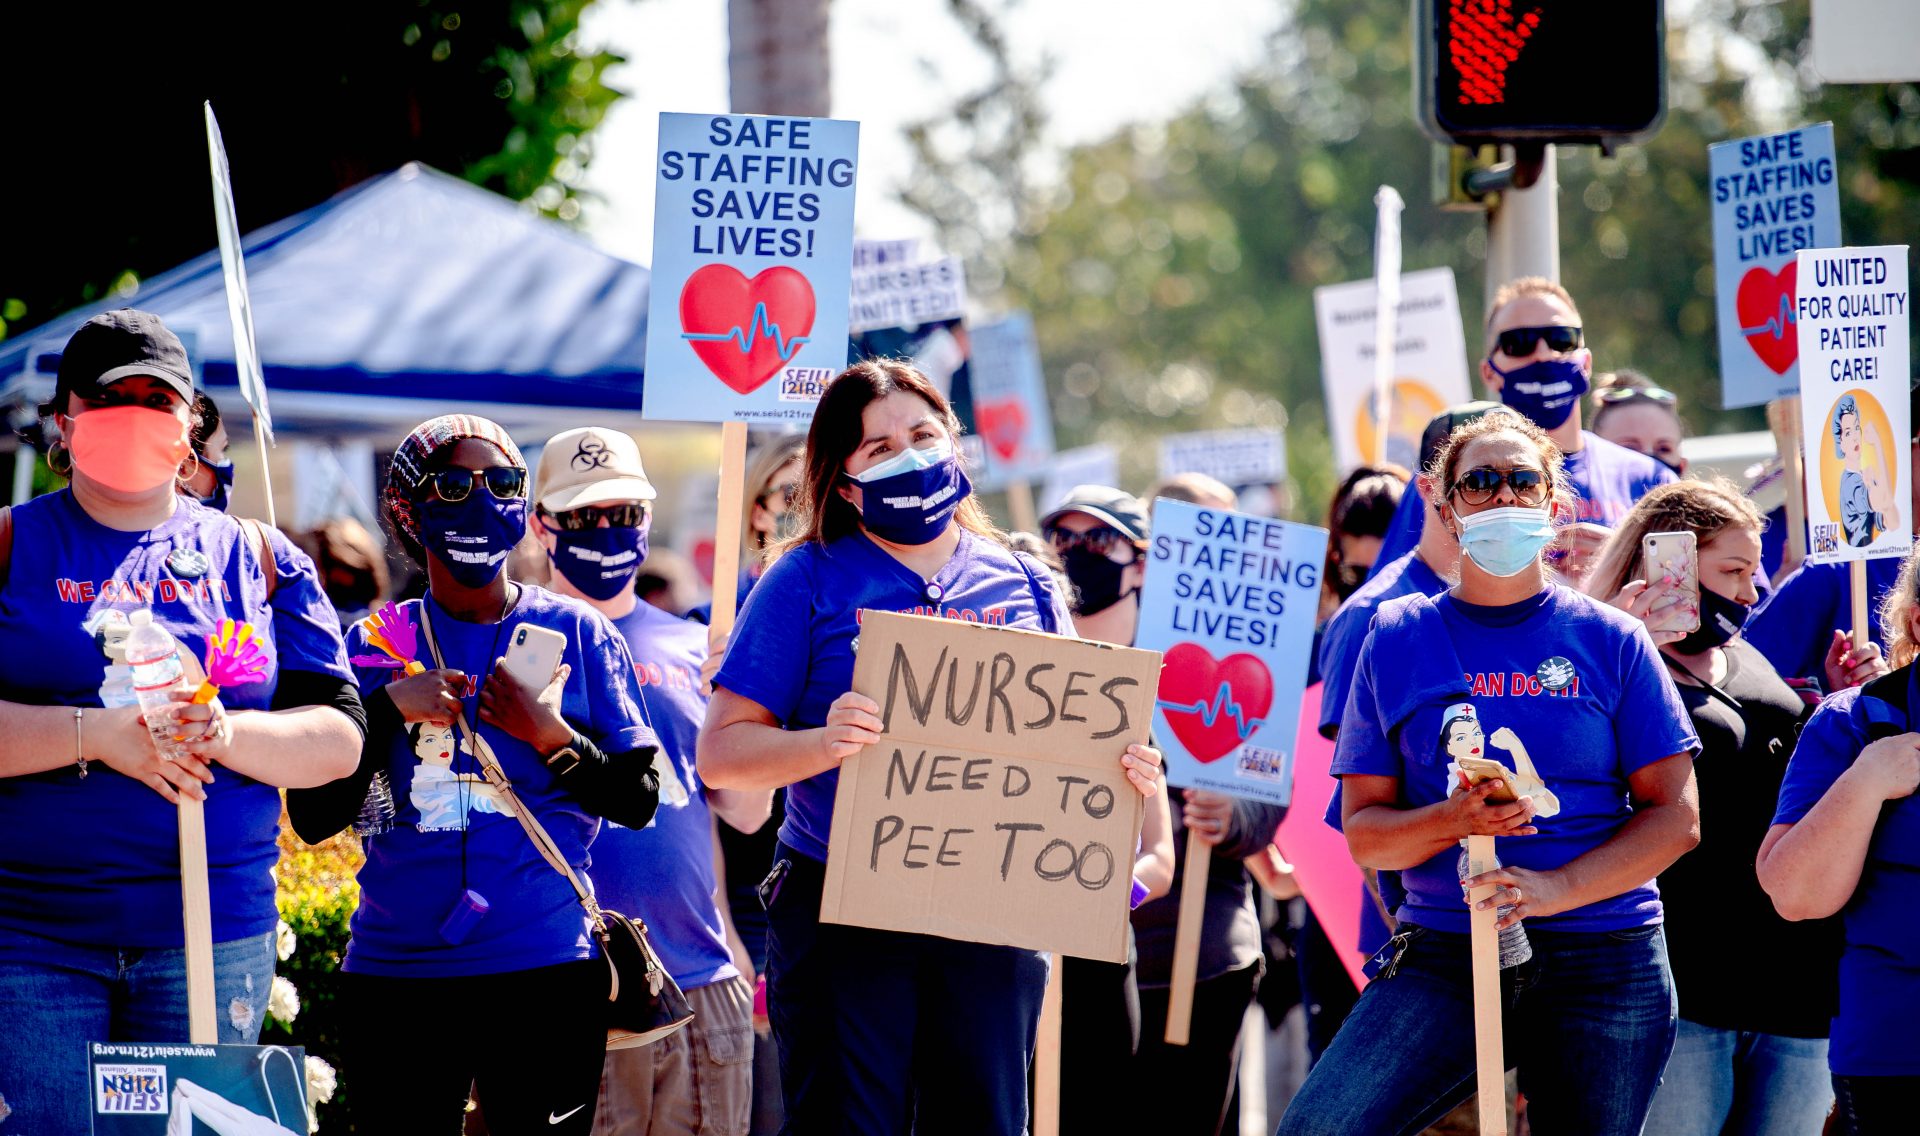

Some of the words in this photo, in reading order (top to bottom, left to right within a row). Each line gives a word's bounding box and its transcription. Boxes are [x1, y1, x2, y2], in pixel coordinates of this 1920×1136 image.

[709, 116, 811, 150] SAFE
[1741, 131, 1803, 167] SAFE
[661, 151, 854, 188] STAFFING
[1715, 157, 1833, 203] STAFFING
[691, 188, 820, 222] SAVES
[1736, 193, 1815, 230] SAVES
[693, 225, 815, 258] LIVES!
[1738, 225, 1815, 262] LIVES!
[852, 265, 952, 296] URSES
[1815, 257, 1887, 288] UNITED
[1798, 296, 1832, 320] FOR
[1838, 292, 1906, 319] QUALITY
[1820, 325, 1887, 351] PATIENT
[785, 368, 831, 382] SEIU
[1830, 357, 1878, 382] CARE!
[1195, 511, 1284, 550] SAFE
[1813, 524, 1838, 539] SEIU
[1154, 535, 1317, 588] STAFFING
[56, 578, 97, 603] WE
[101, 578, 154, 604] CAN
[159, 578, 195, 603] DO
[197, 579, 232, 602] IT!
[1175, 573, 1285, 615] SAVES
[1172, 605, 1279, 648] LIVES!
[882, 642, 1138, 740] NURSES
[1511, 672, 1543, 697] DO
[885, 748, 1031, 800] NEED
[1057, 775, 1115, 819] TO
[870, 815, 975, 872] PEE
[994, 822, 1115, 891] TOO
[93, 1043, 216, 1059] www.seiu121rn.org
[104, 1092, 162, 1111] SEIU
